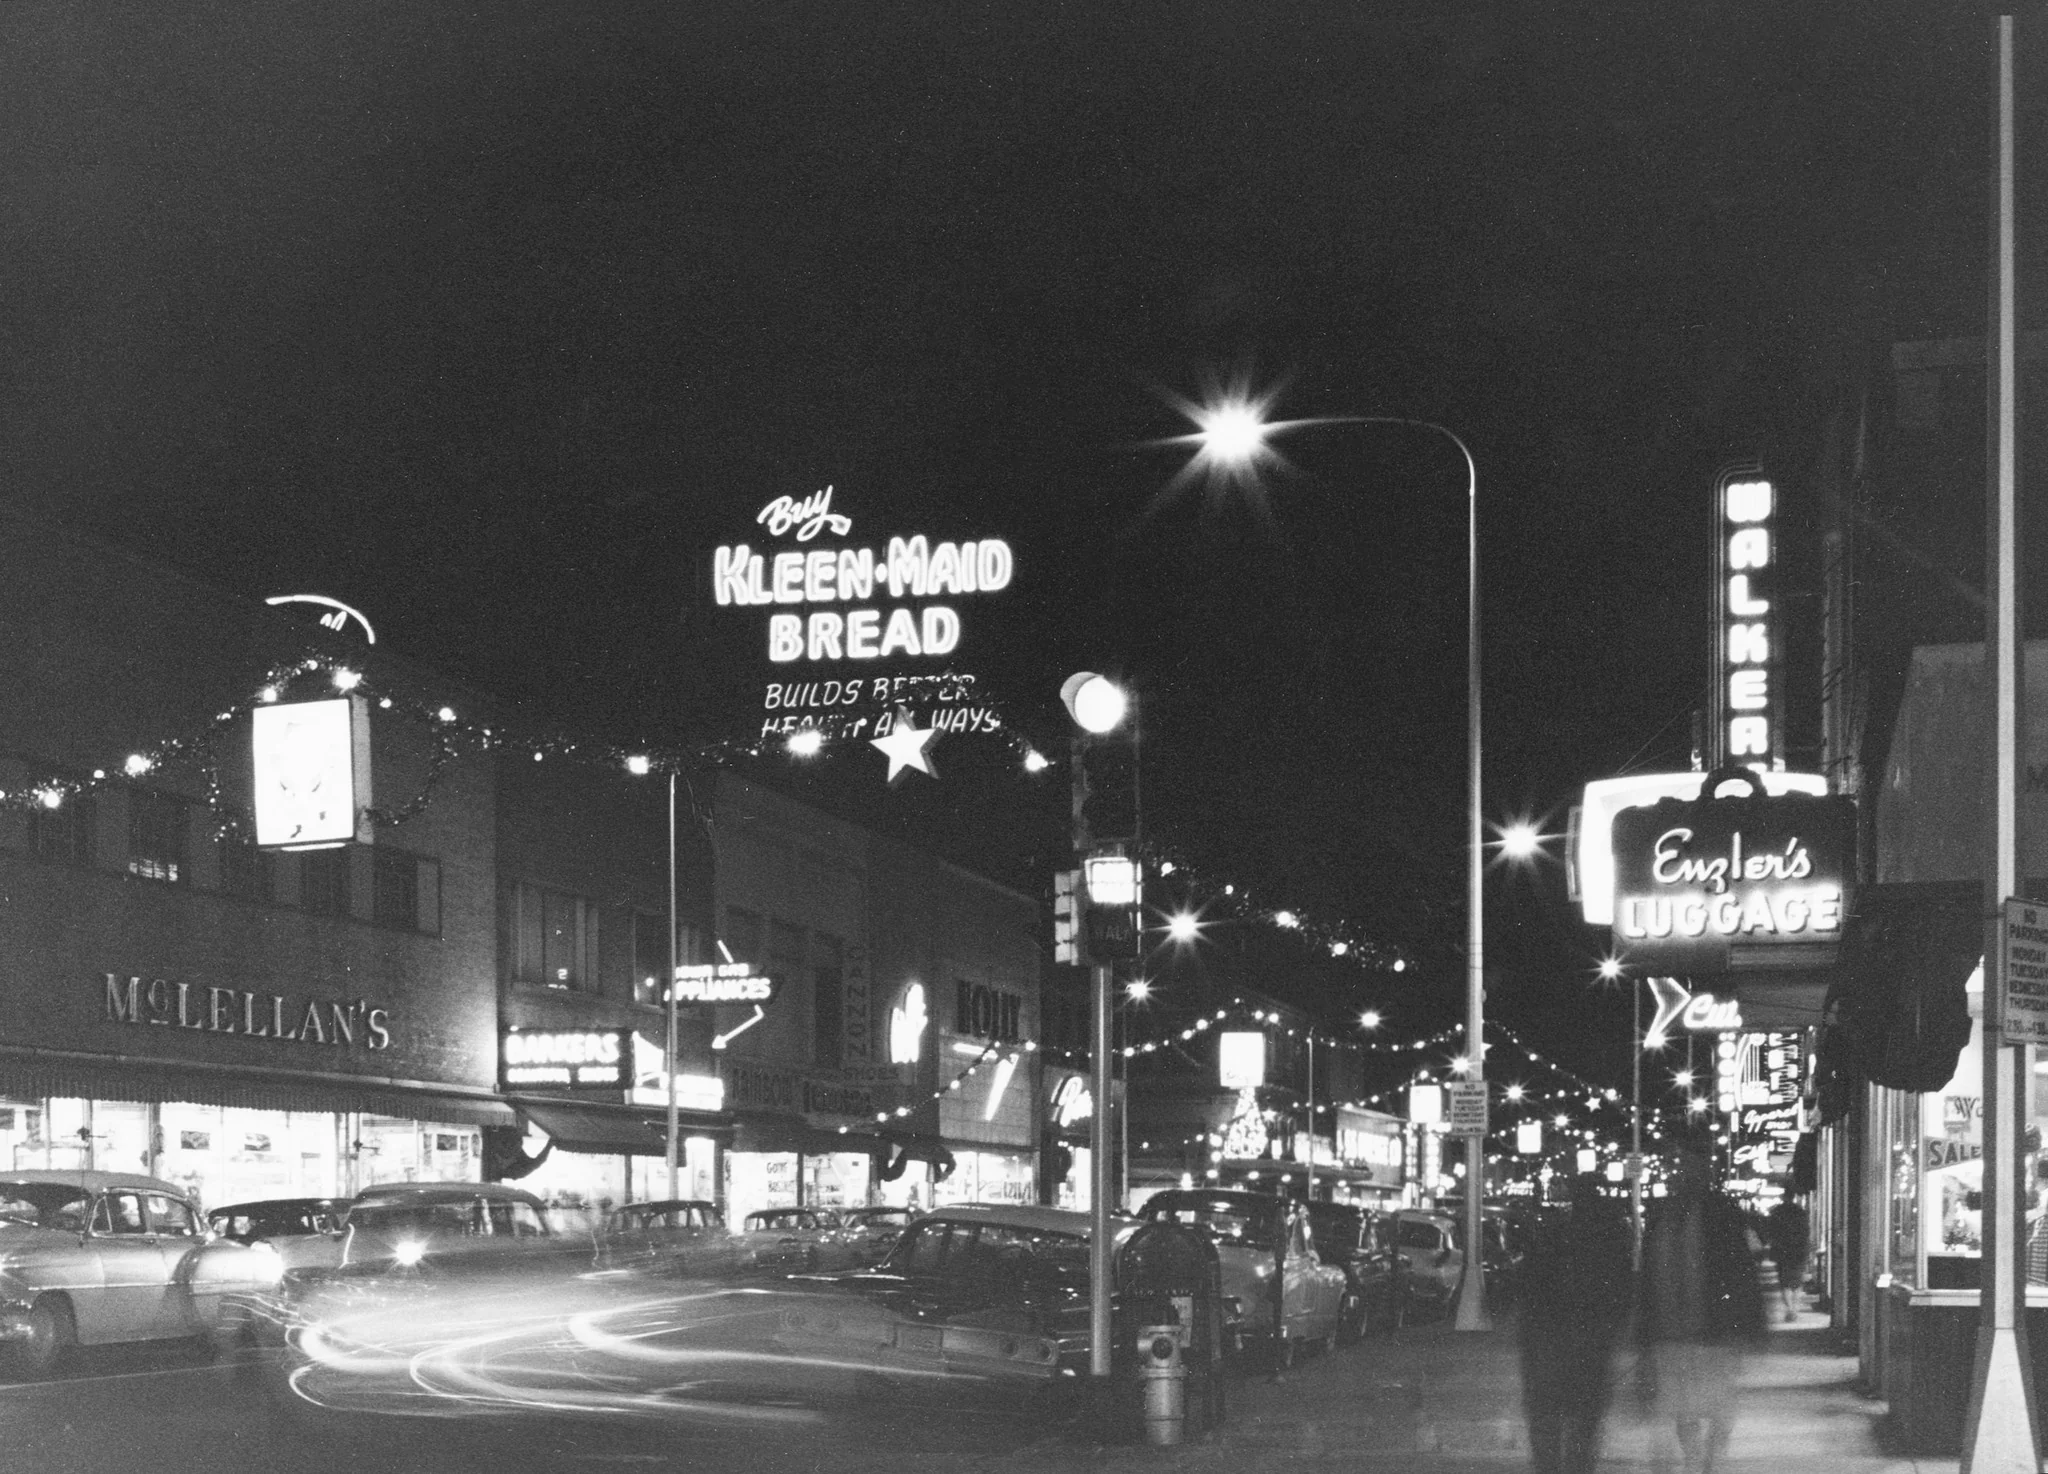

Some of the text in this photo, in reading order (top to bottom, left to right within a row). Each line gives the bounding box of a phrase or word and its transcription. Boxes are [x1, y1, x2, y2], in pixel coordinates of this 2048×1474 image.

[757, 485, 852, 541] Buy
[768, 606, 961, 662] BREAD
[1726, 481, 1772, 772] WALKER
[764, 680, 863, 709] BUILDS
[1652, 828, 1812, 893] Enzler's
[1624, 883, 1840, 938] LUGGAGE
[1930, 1141, 1981, 1166] SALE
